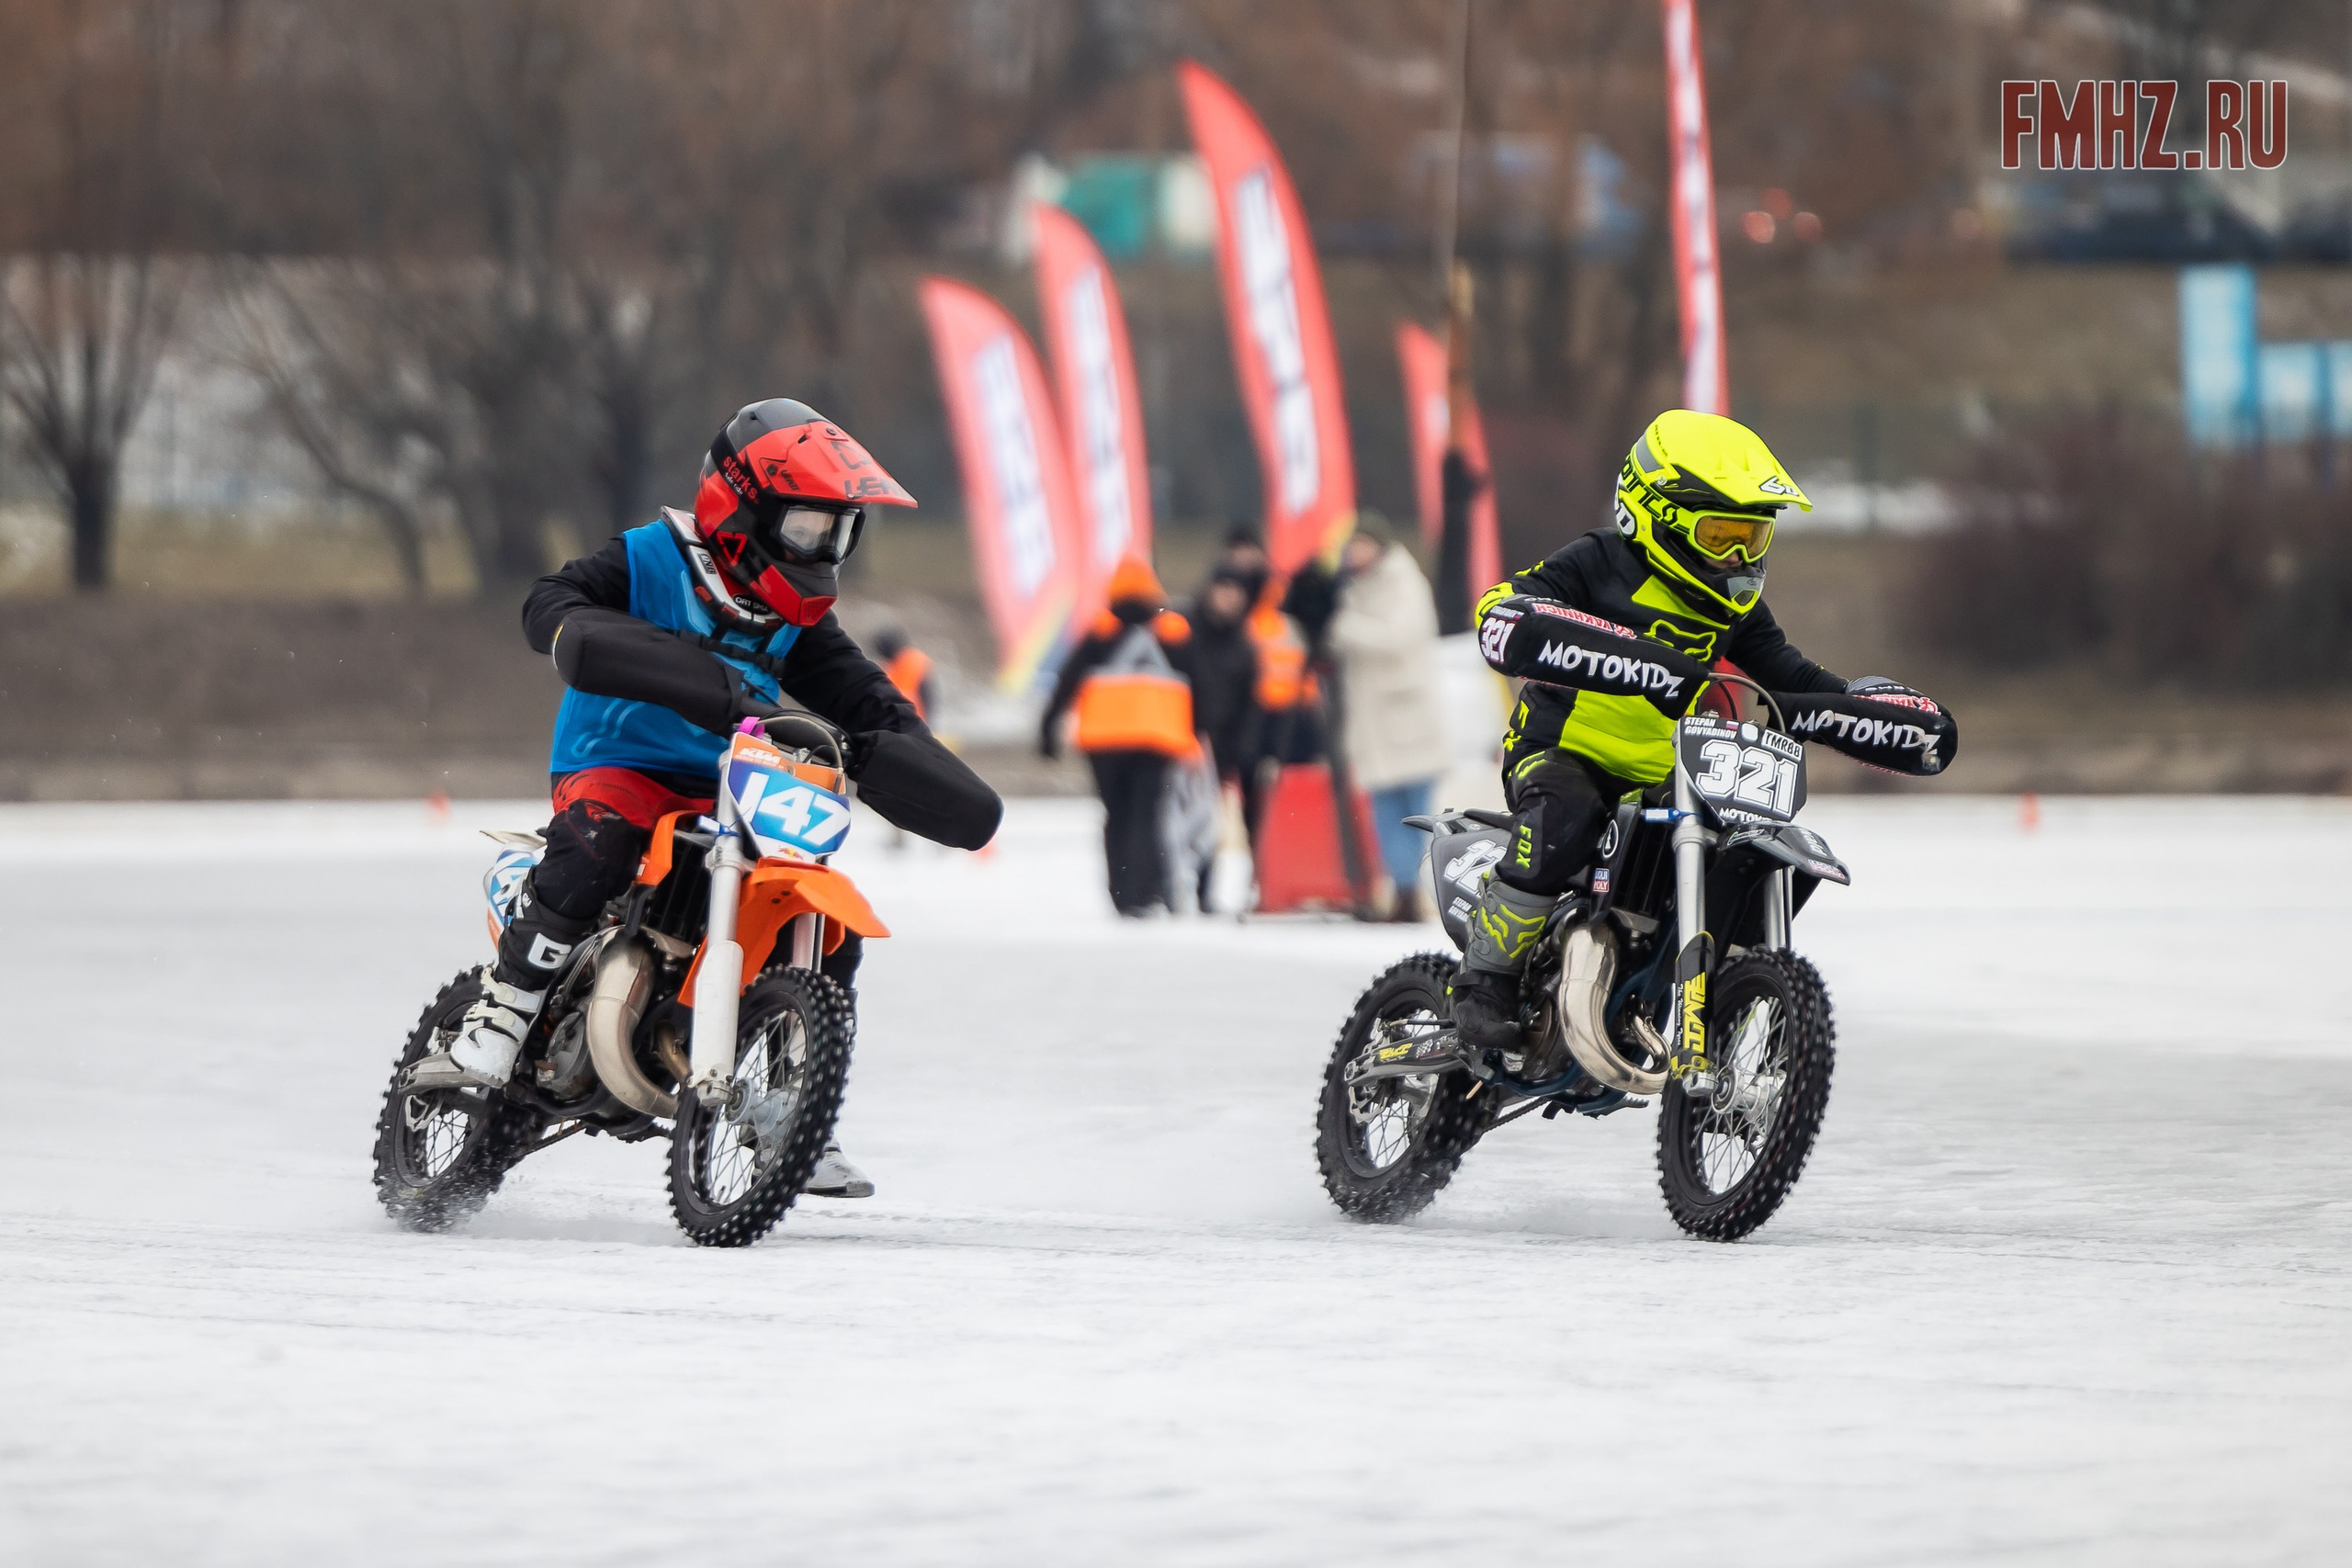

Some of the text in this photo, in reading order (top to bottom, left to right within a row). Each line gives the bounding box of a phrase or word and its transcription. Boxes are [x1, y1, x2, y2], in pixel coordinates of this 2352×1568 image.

[723, 456, 758, 499] starks
[1480, 616, 1516, 664] 321
[1538, 638, 1685, 699] MOTOKIDZ
[1684, 716, 1716, 727] STEPAN
[1684, 726, 1737, 739] GOVYADINOV
[1792, 709, 1941, 755] MOTOKIDZ
[1695, 739, 1799, 818] 321
[739, 771, 852, 846] 147
[1443, 839, 1509, 898] 32
[1516, 824, 1532, 870] FOX
